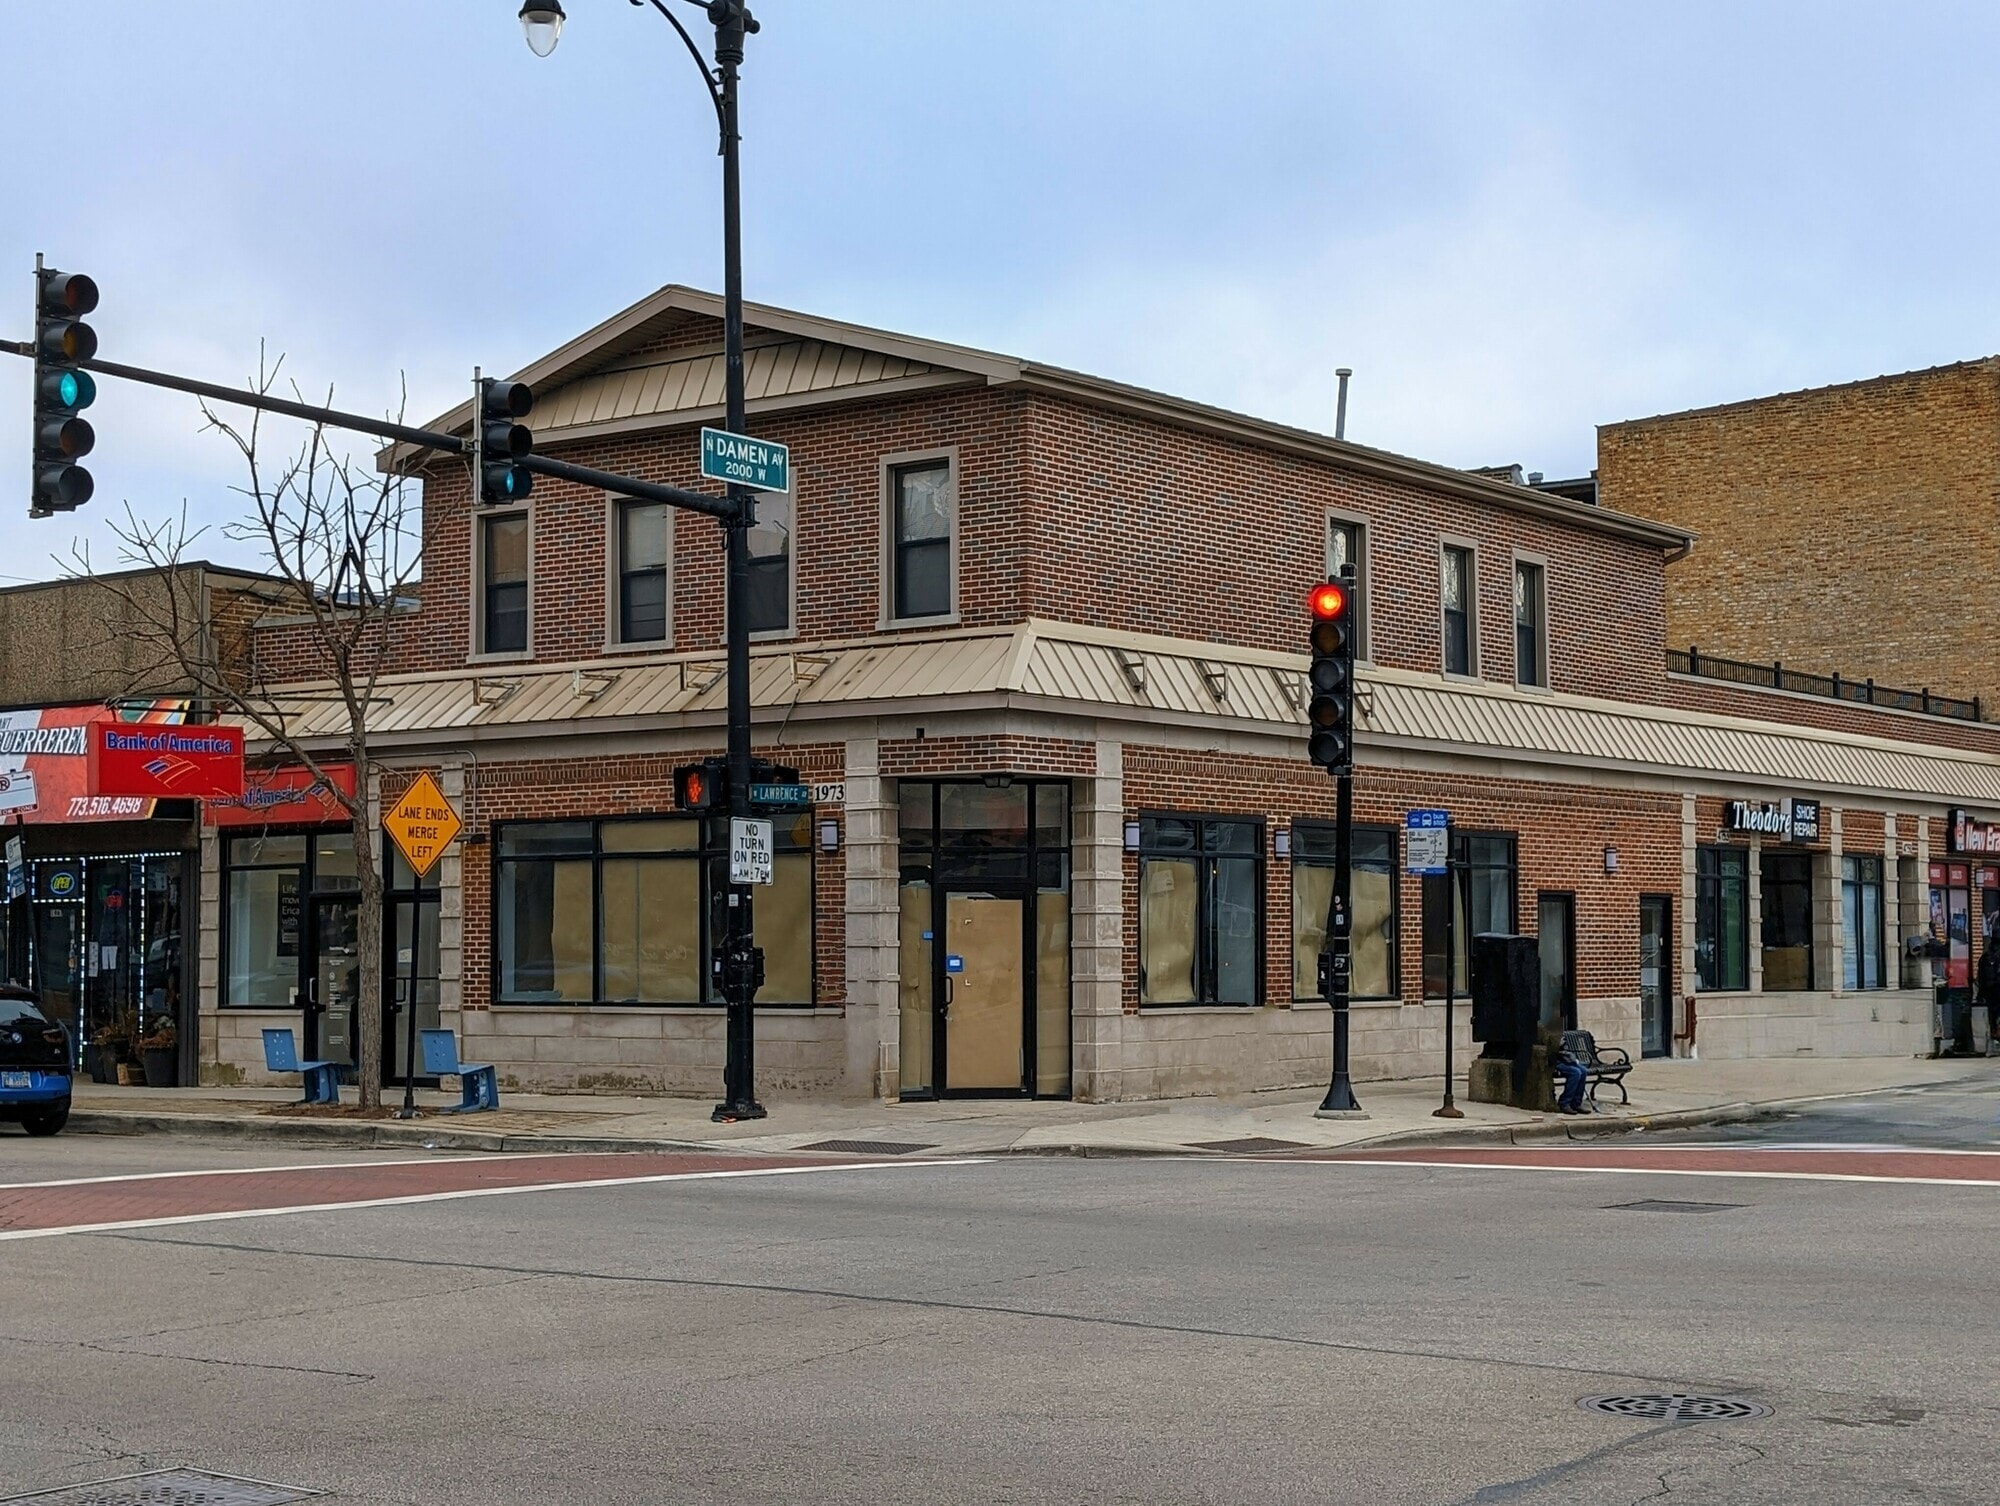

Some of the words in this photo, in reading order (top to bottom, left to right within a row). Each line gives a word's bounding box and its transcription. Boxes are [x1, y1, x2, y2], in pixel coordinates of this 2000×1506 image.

[706, 438, 714, 451] N
[716, 438, 768, 466] DAMEN
[771, 453, 784, 467] AV
[725, 461, 753, 478] 2000
[757, 468, 766, 481] W
[0, 726, 88, 756] UERREREN
[105, 730, 149, 750] Bank
[148, 732, 167, 751] of
[167, 733, 233, 753] America
[760, 786, 799, 801] LAWRENCE
[814, 784, 845, 801] 1973
[66, 796, 143, 817] 773.516.4698
[398, 807, 422, 819] LANE
[425, 808, 449, 821] ENDS
[1796, 805, 1816, 820] SHOE
[1733, 801, 1791, 833] Theodore
[407, 826, 438, 839] MERGE
[745, 823, 759, 837] NO
[1794, 821, 1818, 837] REPAIR
[740, 837, 765, 851] TURN
[1965, 823, 1986, 851] New
[411, 845, 433, 858] LEFT
[734, 850, 747, 863] ON
[751, 852, 770, 864] RED
[282, 905, 300, 915] Erica
